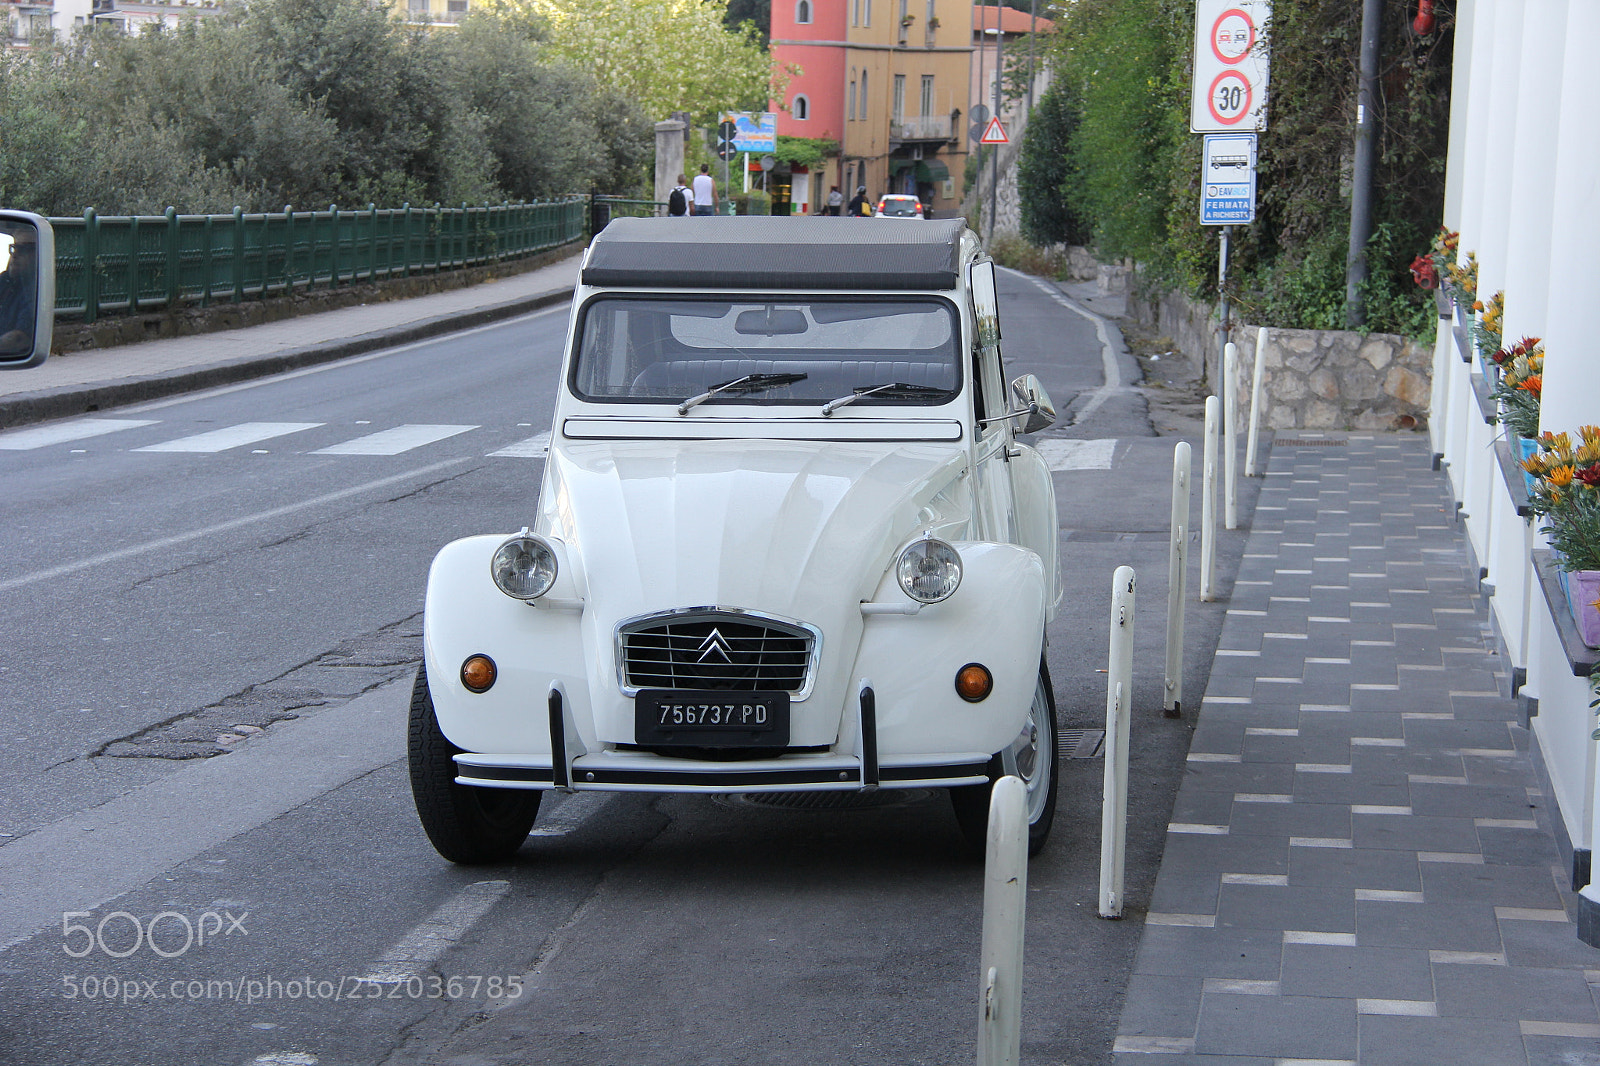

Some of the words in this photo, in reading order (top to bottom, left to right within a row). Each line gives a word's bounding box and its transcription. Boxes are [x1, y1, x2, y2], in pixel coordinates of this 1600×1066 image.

[1219, 86, 1240, 110] 30
[1206, 201, 1249, 209] FERMATA
[660, 704, 735, 724] 756737
[742, 704, 767, 724] PD
